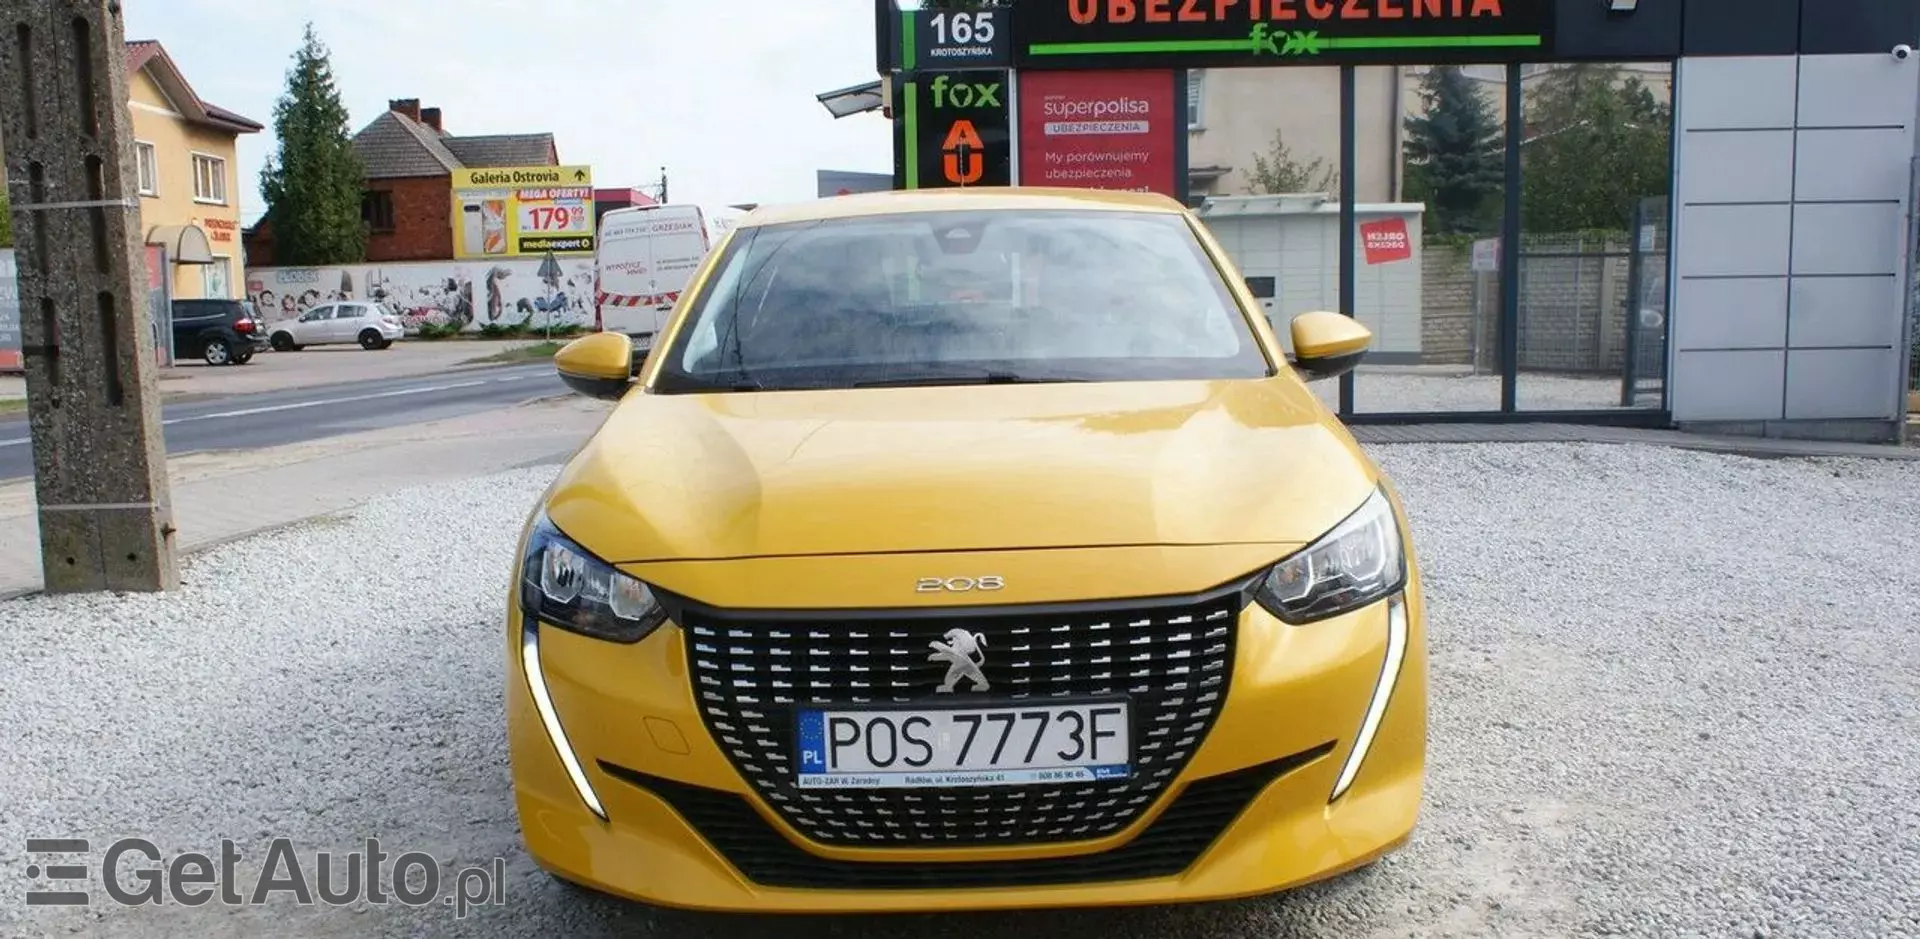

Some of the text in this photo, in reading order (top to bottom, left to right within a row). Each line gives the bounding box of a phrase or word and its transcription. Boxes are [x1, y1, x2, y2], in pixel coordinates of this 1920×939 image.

[930, 12, 994, 44] 165
[1248, 22, 1319, 55] fox
[930, 47, 993, 57] KROTOSZYŃSKA
[930, 75, 1001, 108] fox
[1044, 97, 1149, 119] superpolisa
[1053, 124, 1141, 133] UBEZPIECZENIA
[1045, 151, 1149, 164] My porównujemy
[470, 169, 559, 184] Galeria Ostrovia
[519, 189, 547, 199] MEGA
[529, 207, 569, 229] 179
[522, 239, 580, 249] mediaexpert
[916, 576, 1005, 593] 208
[829, 708, 1121, 769] POS 7773F
[802, 750, 823, 765] PL
